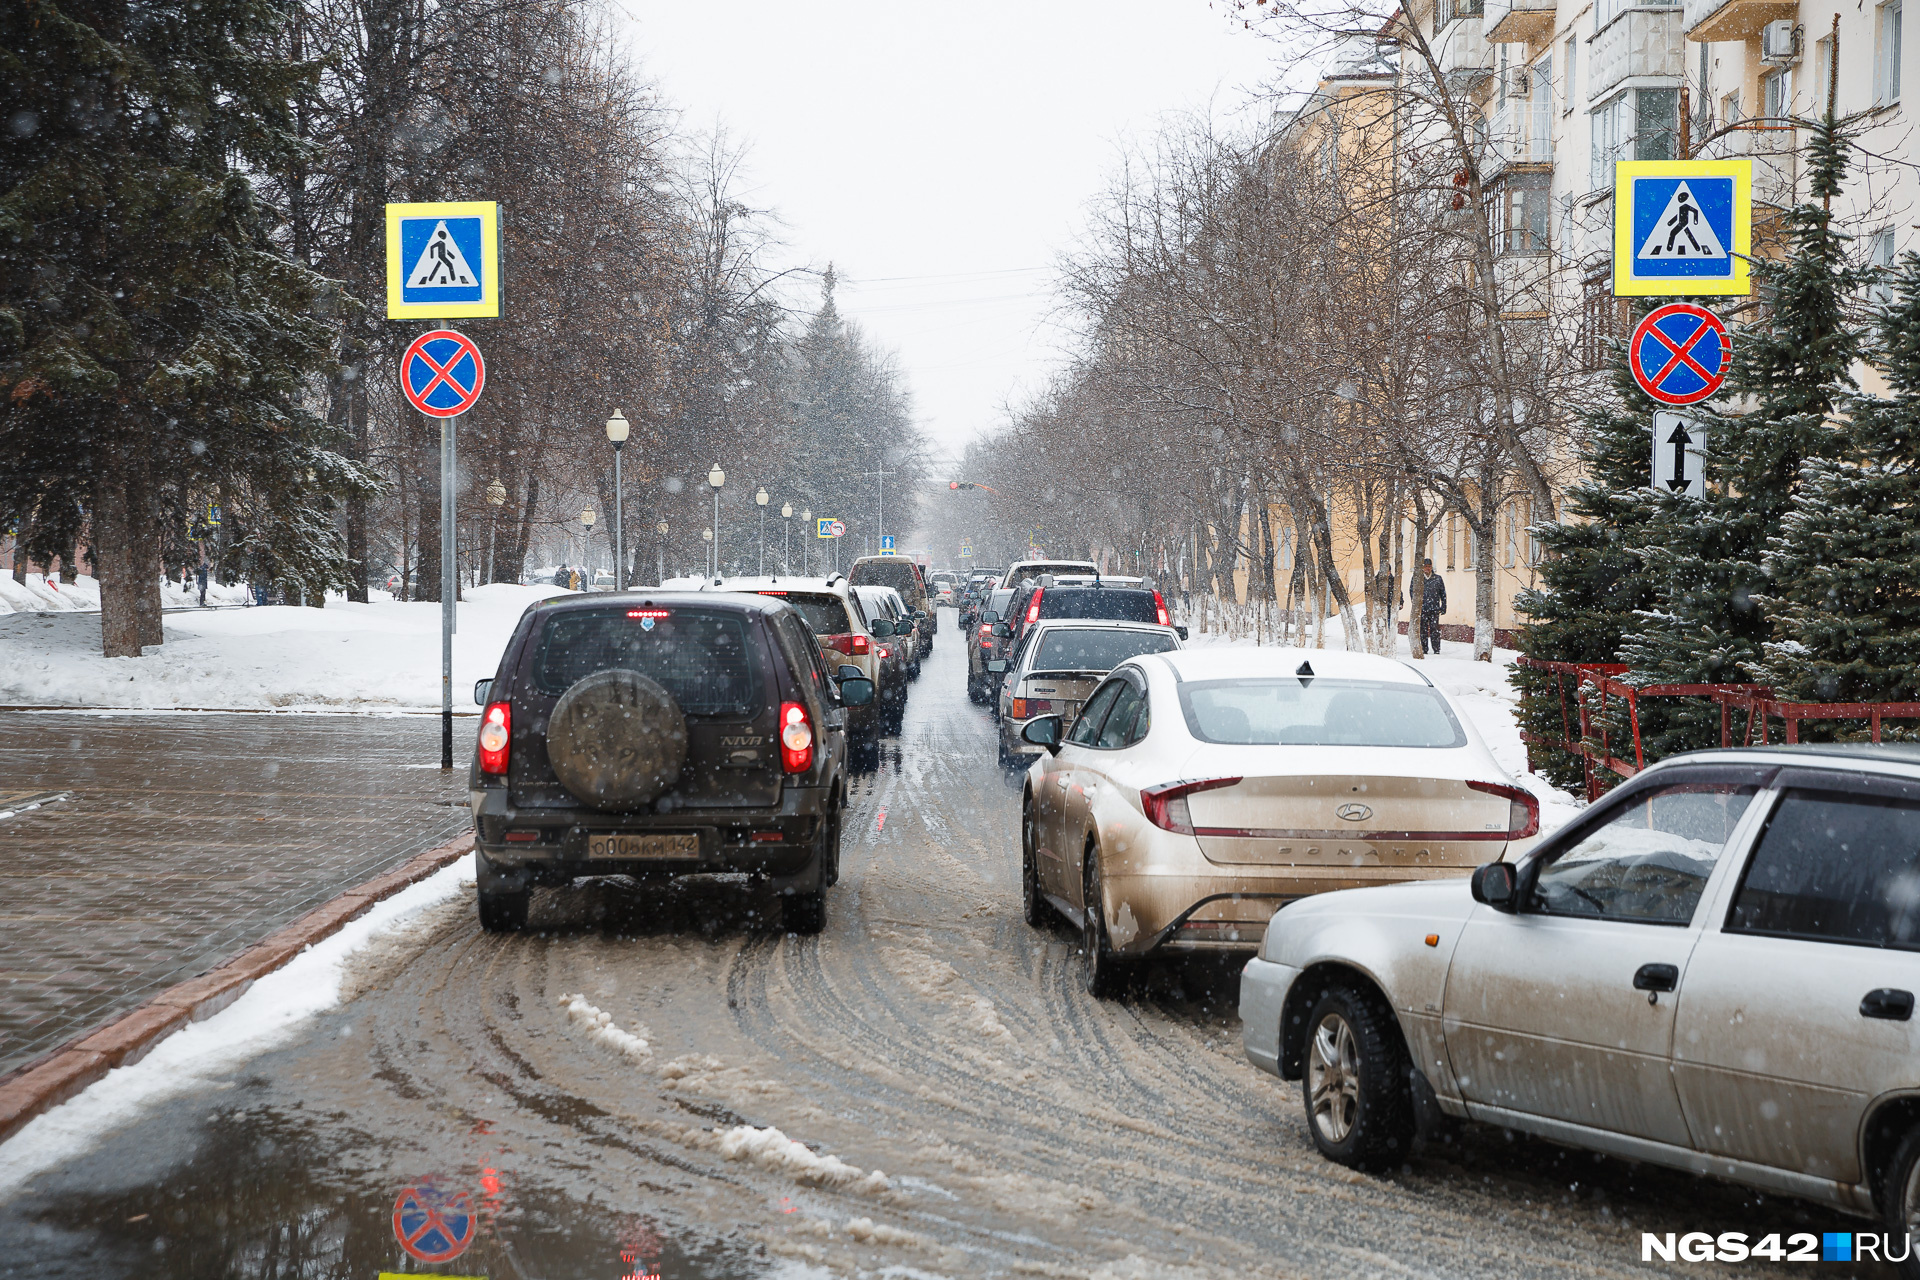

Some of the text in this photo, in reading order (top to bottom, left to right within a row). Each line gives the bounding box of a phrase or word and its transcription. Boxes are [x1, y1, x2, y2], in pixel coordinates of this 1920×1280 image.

[721, 736, 763, 746] NIVA
[668, 837, 695, 851] 142
[1278, 846, 1430, 856] SONATA
